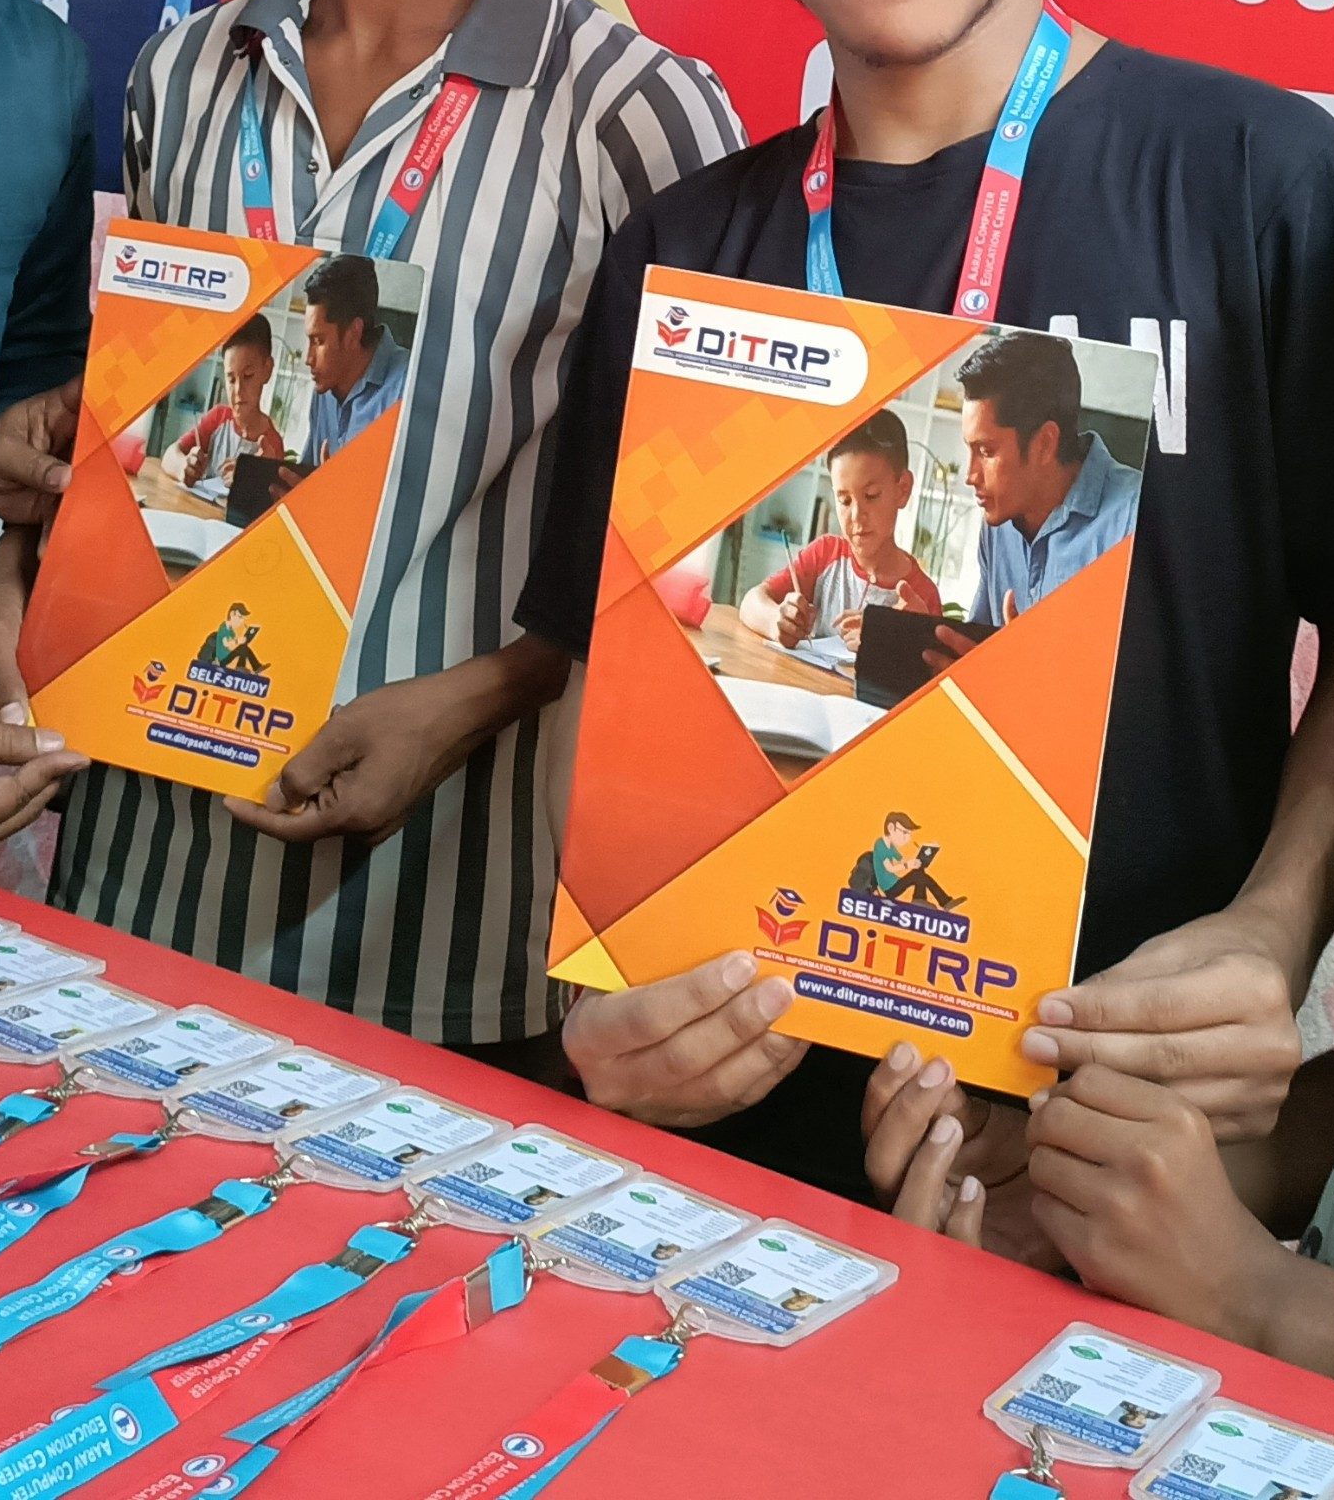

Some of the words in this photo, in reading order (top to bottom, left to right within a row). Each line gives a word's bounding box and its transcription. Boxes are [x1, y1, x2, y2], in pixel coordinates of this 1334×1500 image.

[1008, 82, 1027, 116] AARAV
[1020, 44, 1047, 87] COMPUTER
[1021, 80, 1048, 119] EDUCATION
[1041, 50, 1060, 80] CENTER
[413, 130, 433, 162] AARAV
[428, 90, 457, 133] COMPUTER
[421, 124, 449, 170] EDUCATION
[446, 94, 468, 128] CENTER
[974, 192, 995, 245] COMPUTER
[979, 227, 1001, 287] EDUCATION
[994, 190, 1010, 228] CENTER
[141, 259, 226, 289] DiTRP
[968, 244, 983, 282] AARAV
[696, 326, 830, 373] DiTRP
[189, 666, 268, 697] SELF-STUDY
[167, 684, 294, 737] DiTRP
[841, 897, 967, 941] SELF-STUDY
[755, 948, 785, 963] DIGITAL
[786, 956, 837, 974] INFORMATION
[838, 967, 889, 987] TECHNOLOGY
[896, 981, 938, 1000] RESEARCH
[939, 992, 955, 1004] FOR
[956, 996, 1015, 1019] PROFESSIONAL
[818, 920, 1017, 998] DiTRP
[799, 979, 969, 1032] www.ditrpself-study.com
[46, 1415, 108, 1459] EDUCATION
[74, 1438, 113, 1475] AARAV
